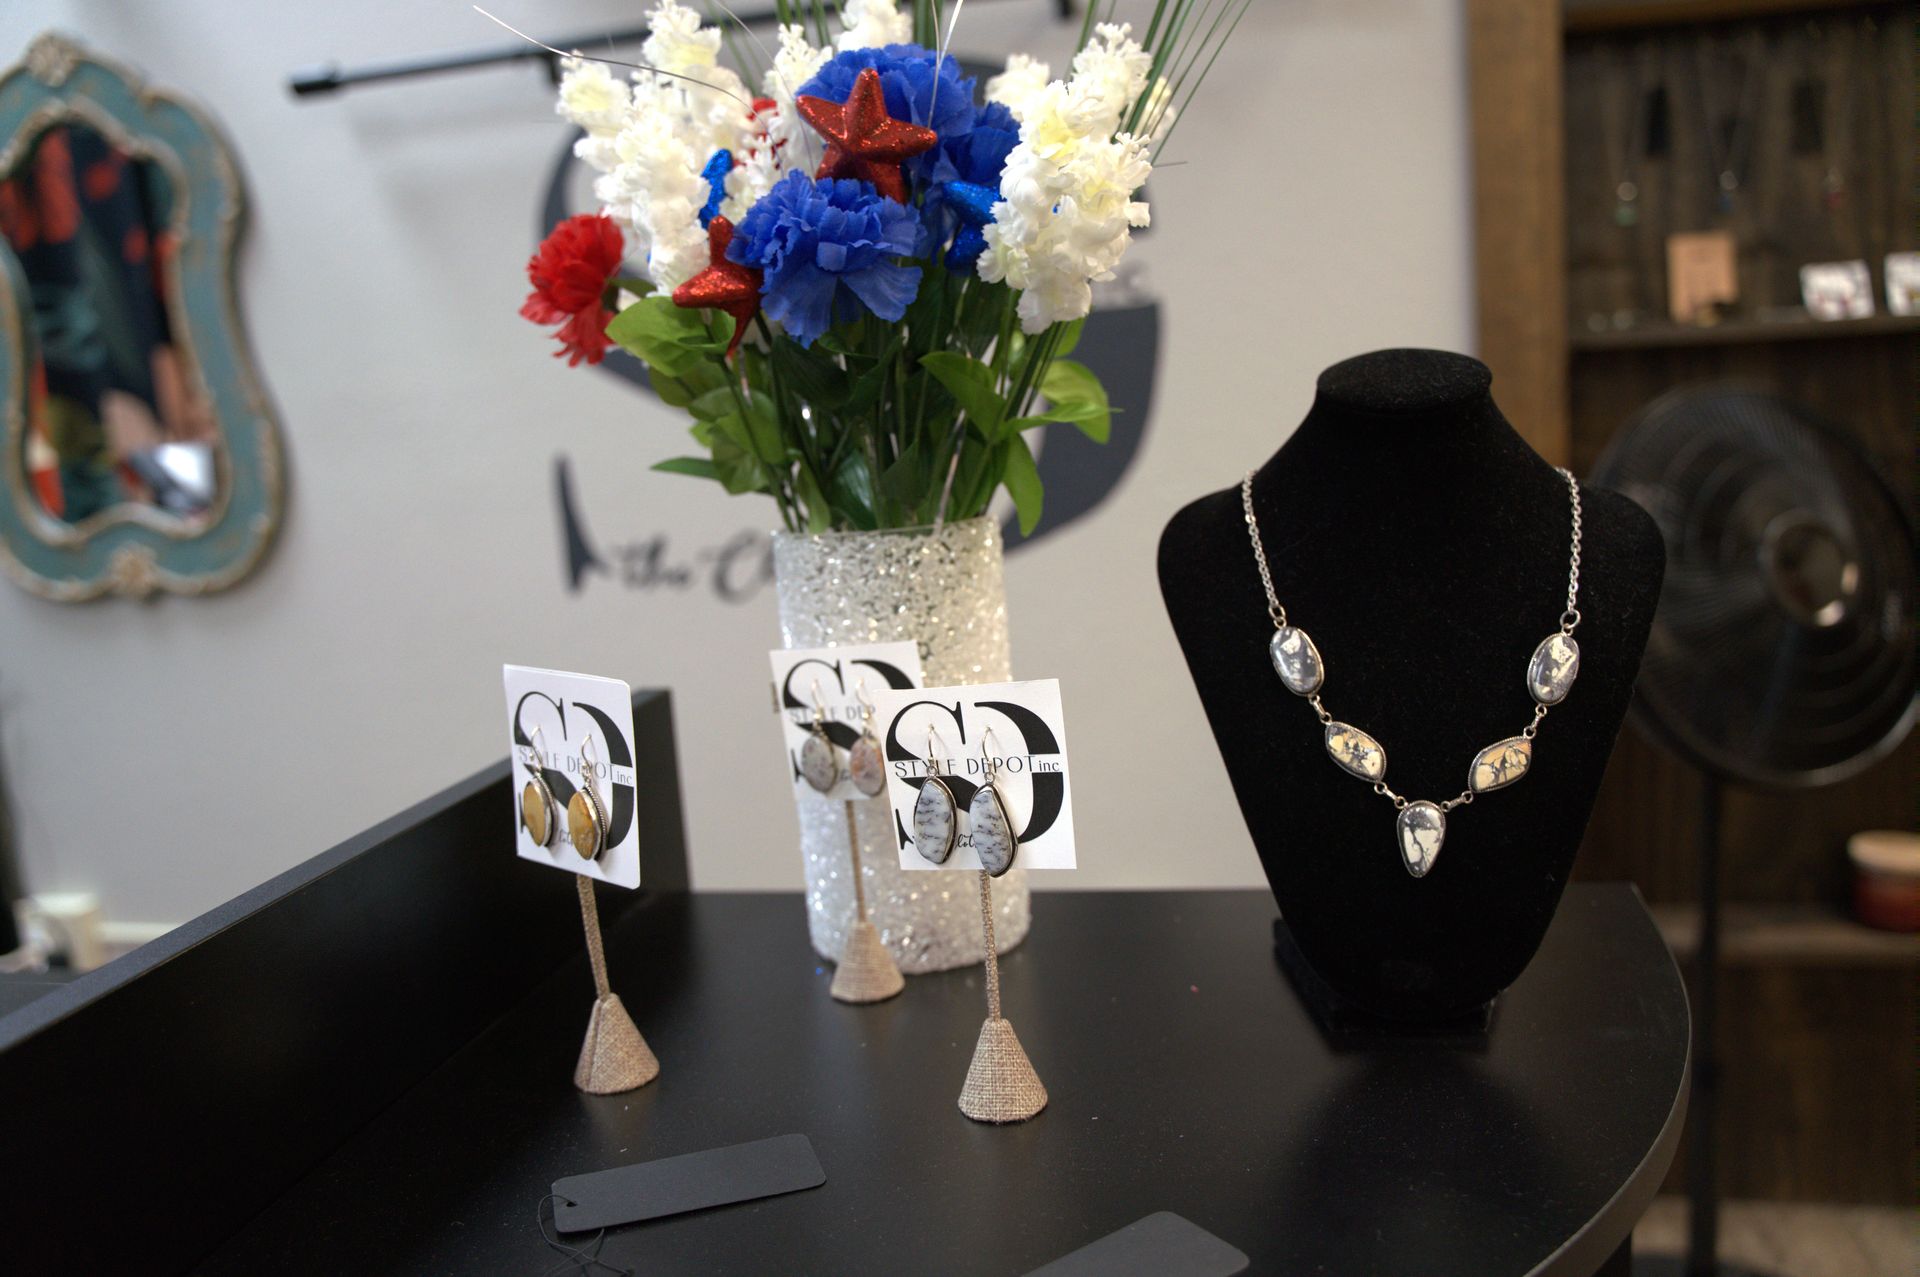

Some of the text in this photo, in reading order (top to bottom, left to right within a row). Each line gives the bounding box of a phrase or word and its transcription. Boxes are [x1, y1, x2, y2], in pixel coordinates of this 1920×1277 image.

[966, 755, 1036, 775] DEPOT
[1038, 759, 1060, 772] inc
[617, 771, 633, 785] inc
